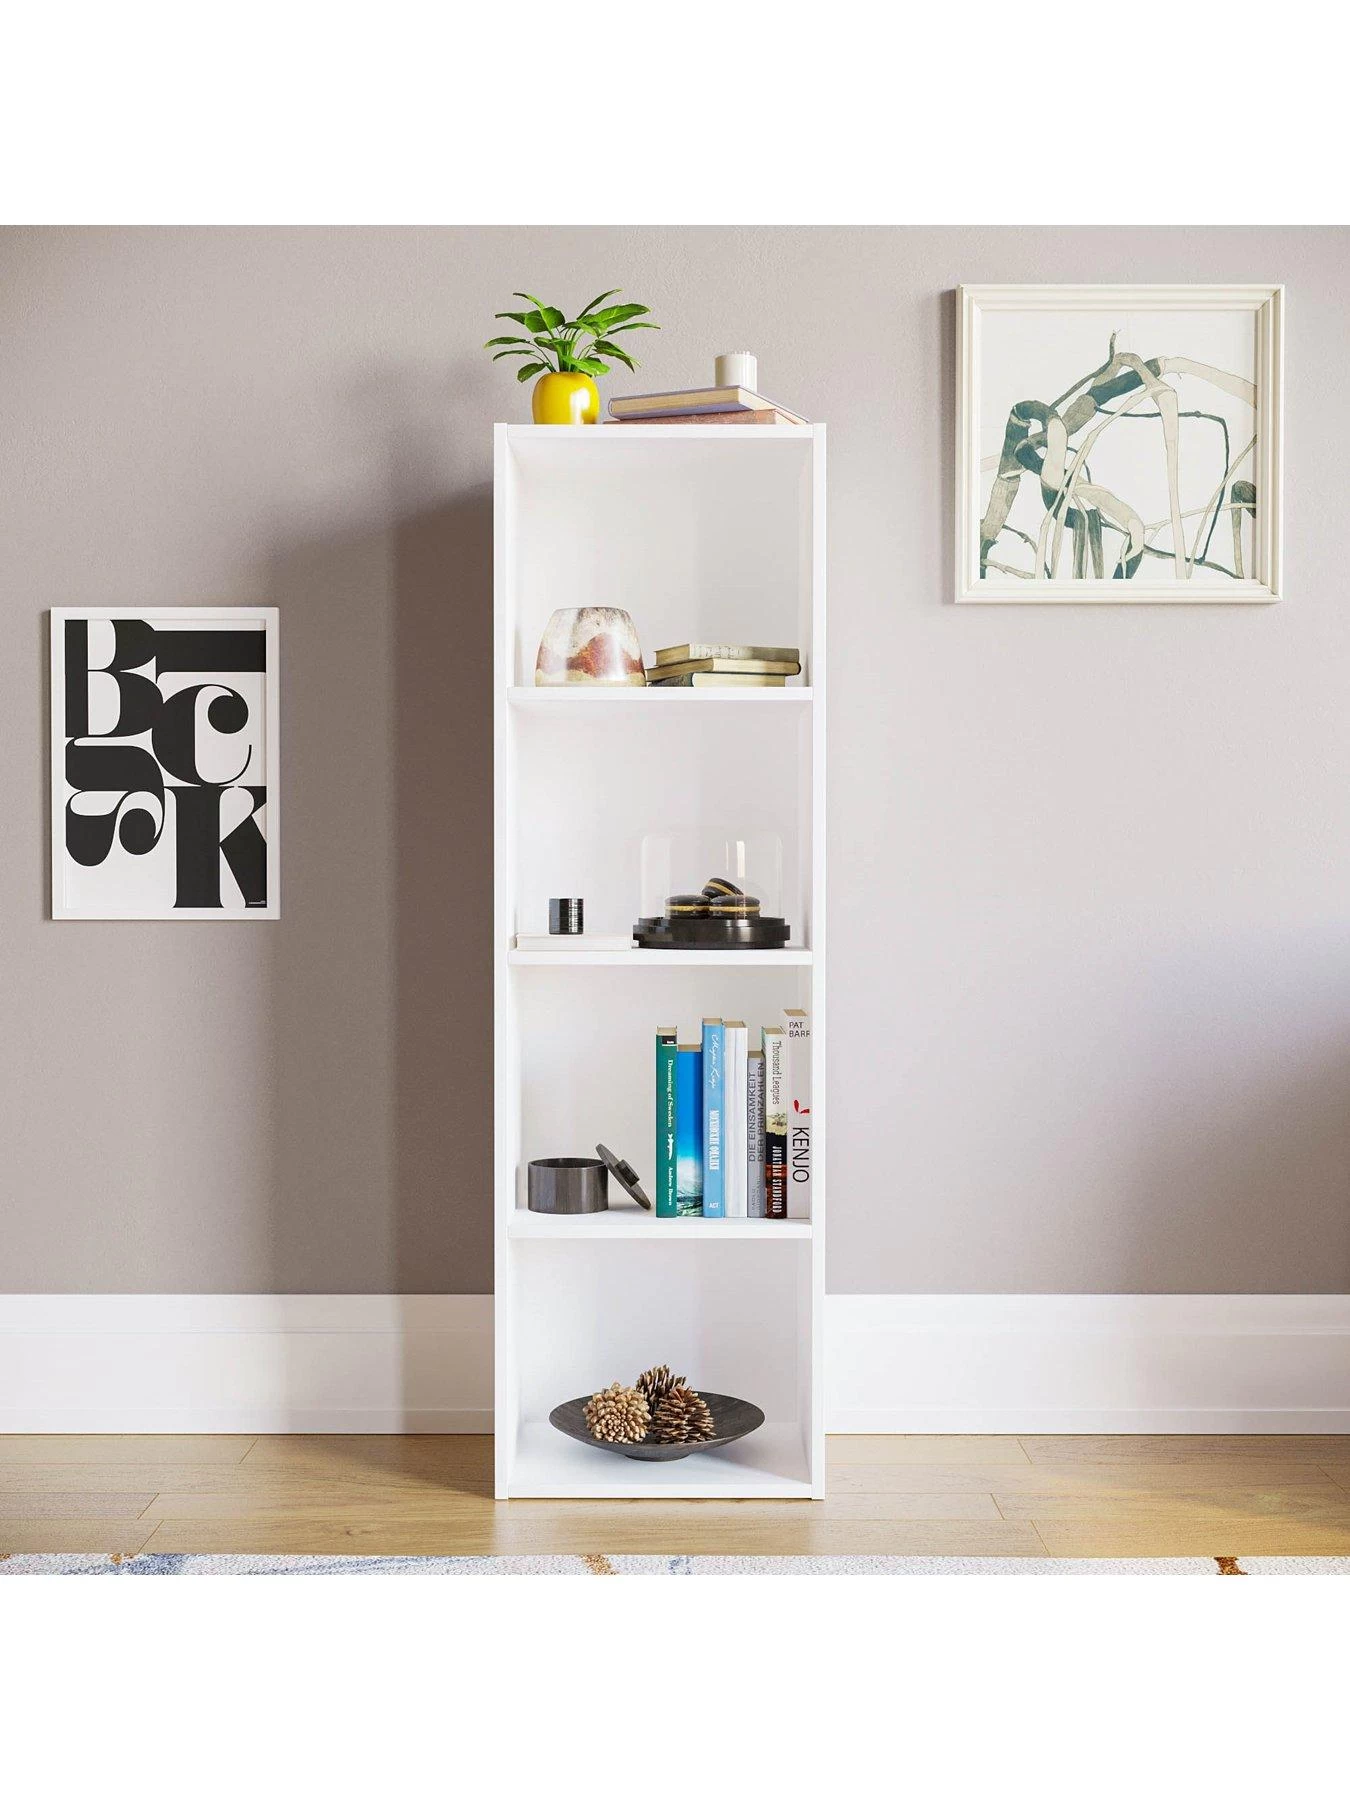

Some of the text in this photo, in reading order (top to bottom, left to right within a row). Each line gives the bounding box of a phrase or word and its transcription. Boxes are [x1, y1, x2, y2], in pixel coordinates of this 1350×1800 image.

[789, 1021, 804, 1029] PAT
[666, 1059, 674, 1092] Dreaming
[770, 1041, 782, 1105] Thousand Leagues
[667, 1093, 674, 1101] of
[772, 1146, 782, 1177] JONATHAN
[792, 1127, 810, 1183] KENJO
